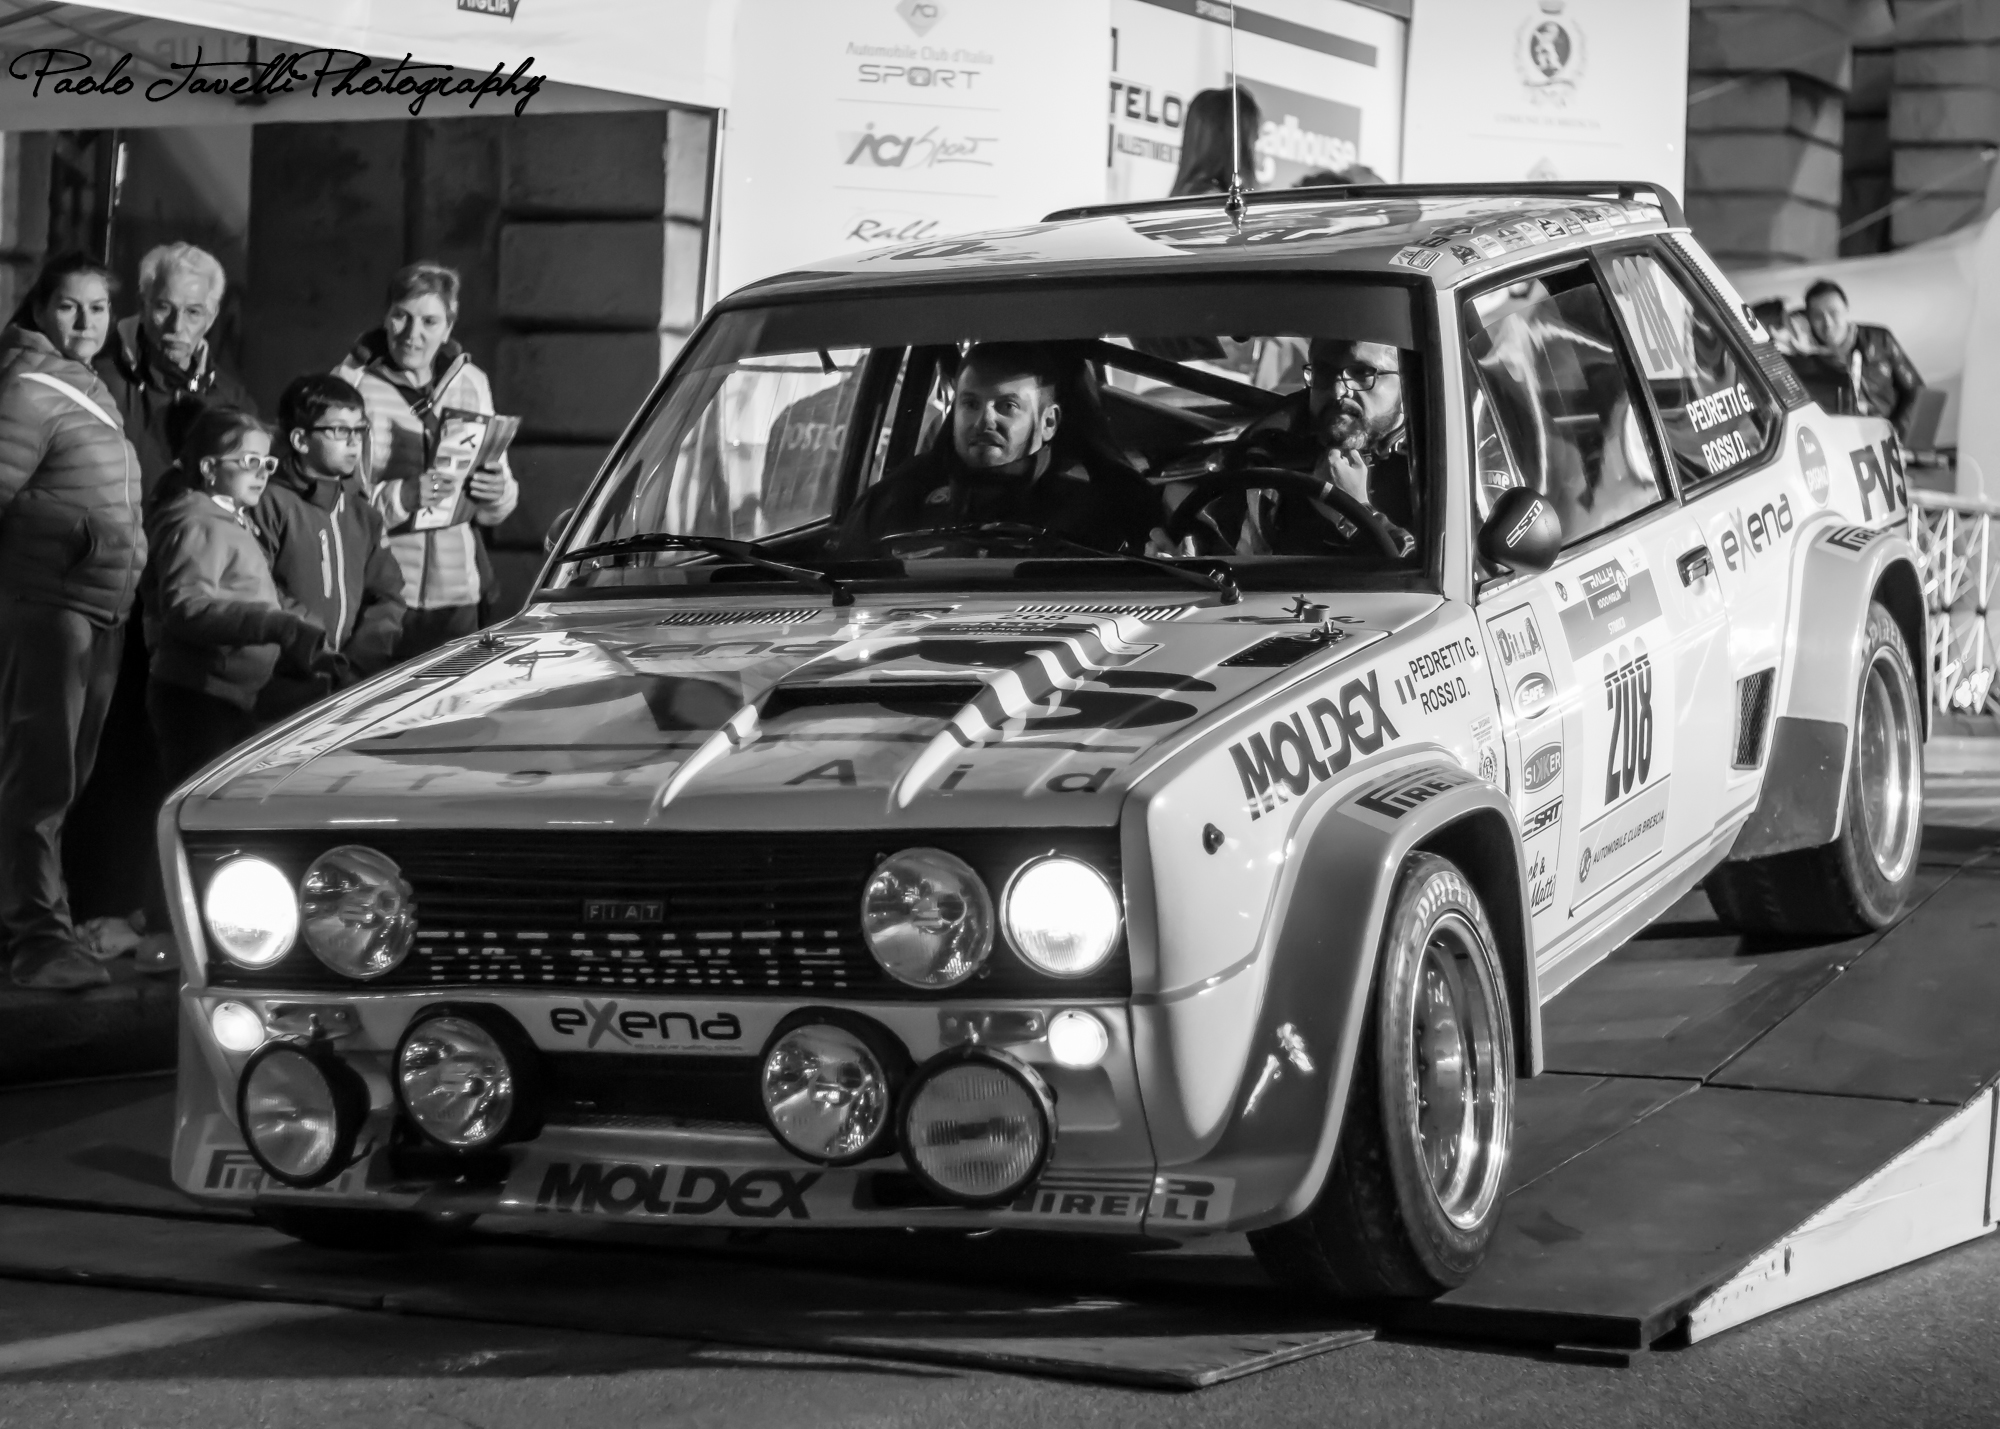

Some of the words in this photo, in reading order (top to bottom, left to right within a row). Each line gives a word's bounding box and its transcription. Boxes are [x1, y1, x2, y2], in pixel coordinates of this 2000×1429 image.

[858, 64, 981, 89] SPORT
[1686, 386, 1738, 433] PEDRETTI
[1701, 433, 1737, 474] ROSSI
[1408, 643, 1466, 682] PEDRETTI
[1419, 680, 1457, 715] ROSSI
[1603, 637, 1653, 806] 208
[1228, 669, 1401, 822] MOLDEX
[1592, 832, 1628, 866] AUTOMOBILE
[1627, 823, 1642, 843] CLUB
[1641, 809, 1664, 833] BRESCIA
[588, 904, 659, 920] FIAT
[535, 1162, 825, 1220] MOLDEX
